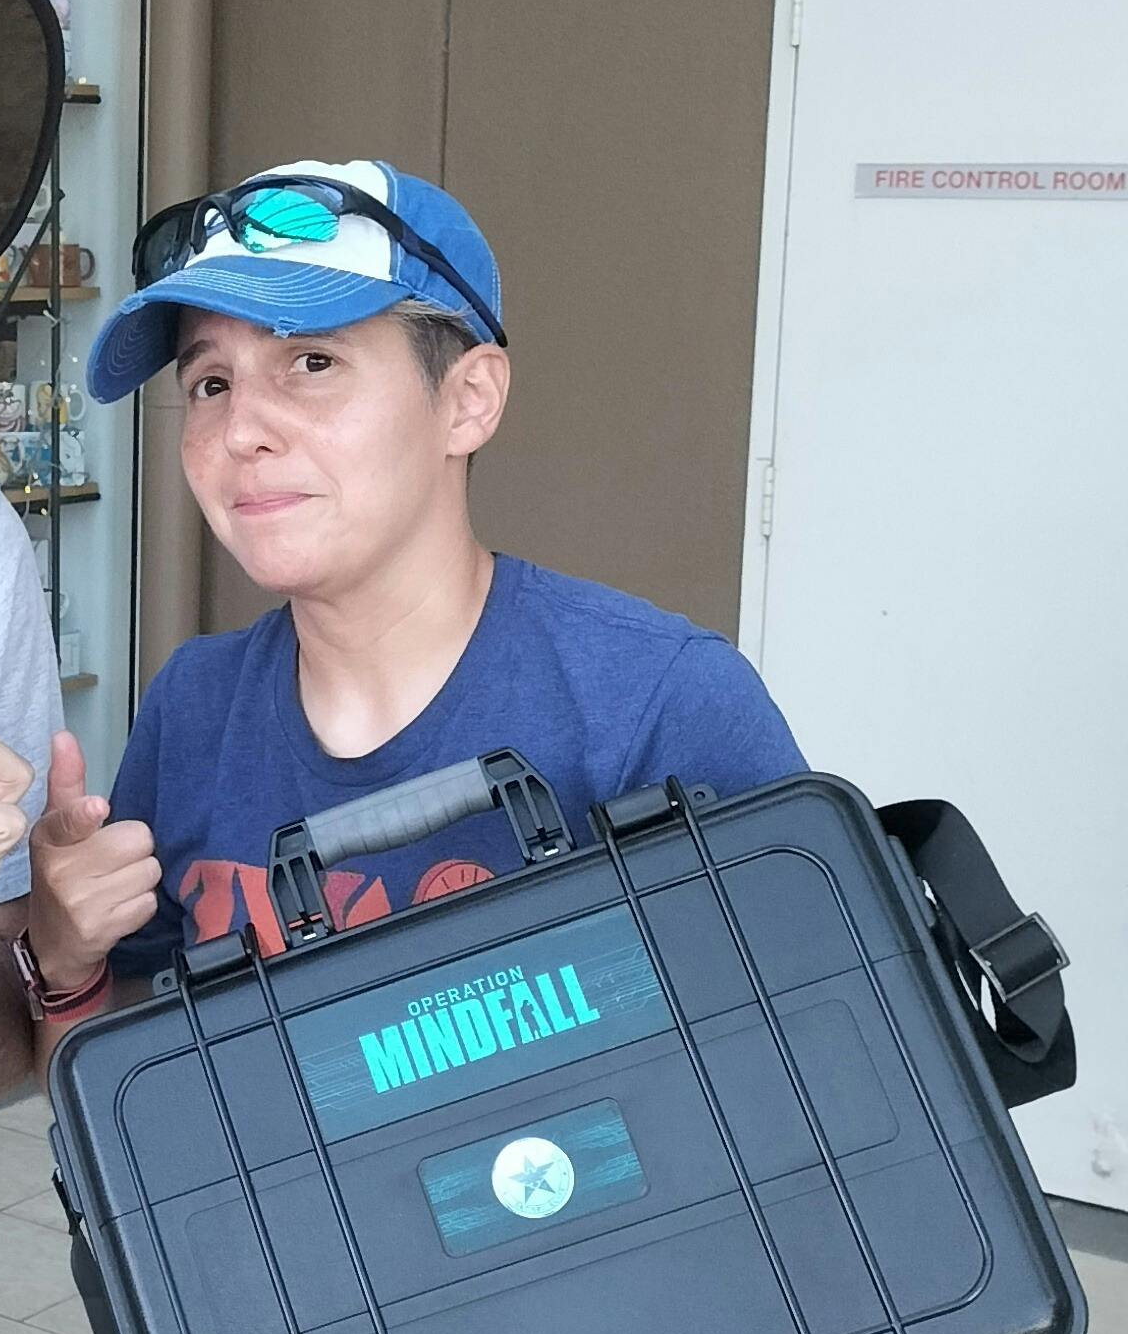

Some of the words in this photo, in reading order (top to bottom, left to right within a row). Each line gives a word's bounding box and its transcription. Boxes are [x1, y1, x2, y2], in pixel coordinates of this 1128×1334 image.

[875, 170, 925, 189] FIRE
[932, 170, 1046, 190] CONTROL
[1052, 171, 1127, 192] ROOM
[407, 965, 525, 1017] OPERATION
[358, 964, 601, 1094] MINDFALL
